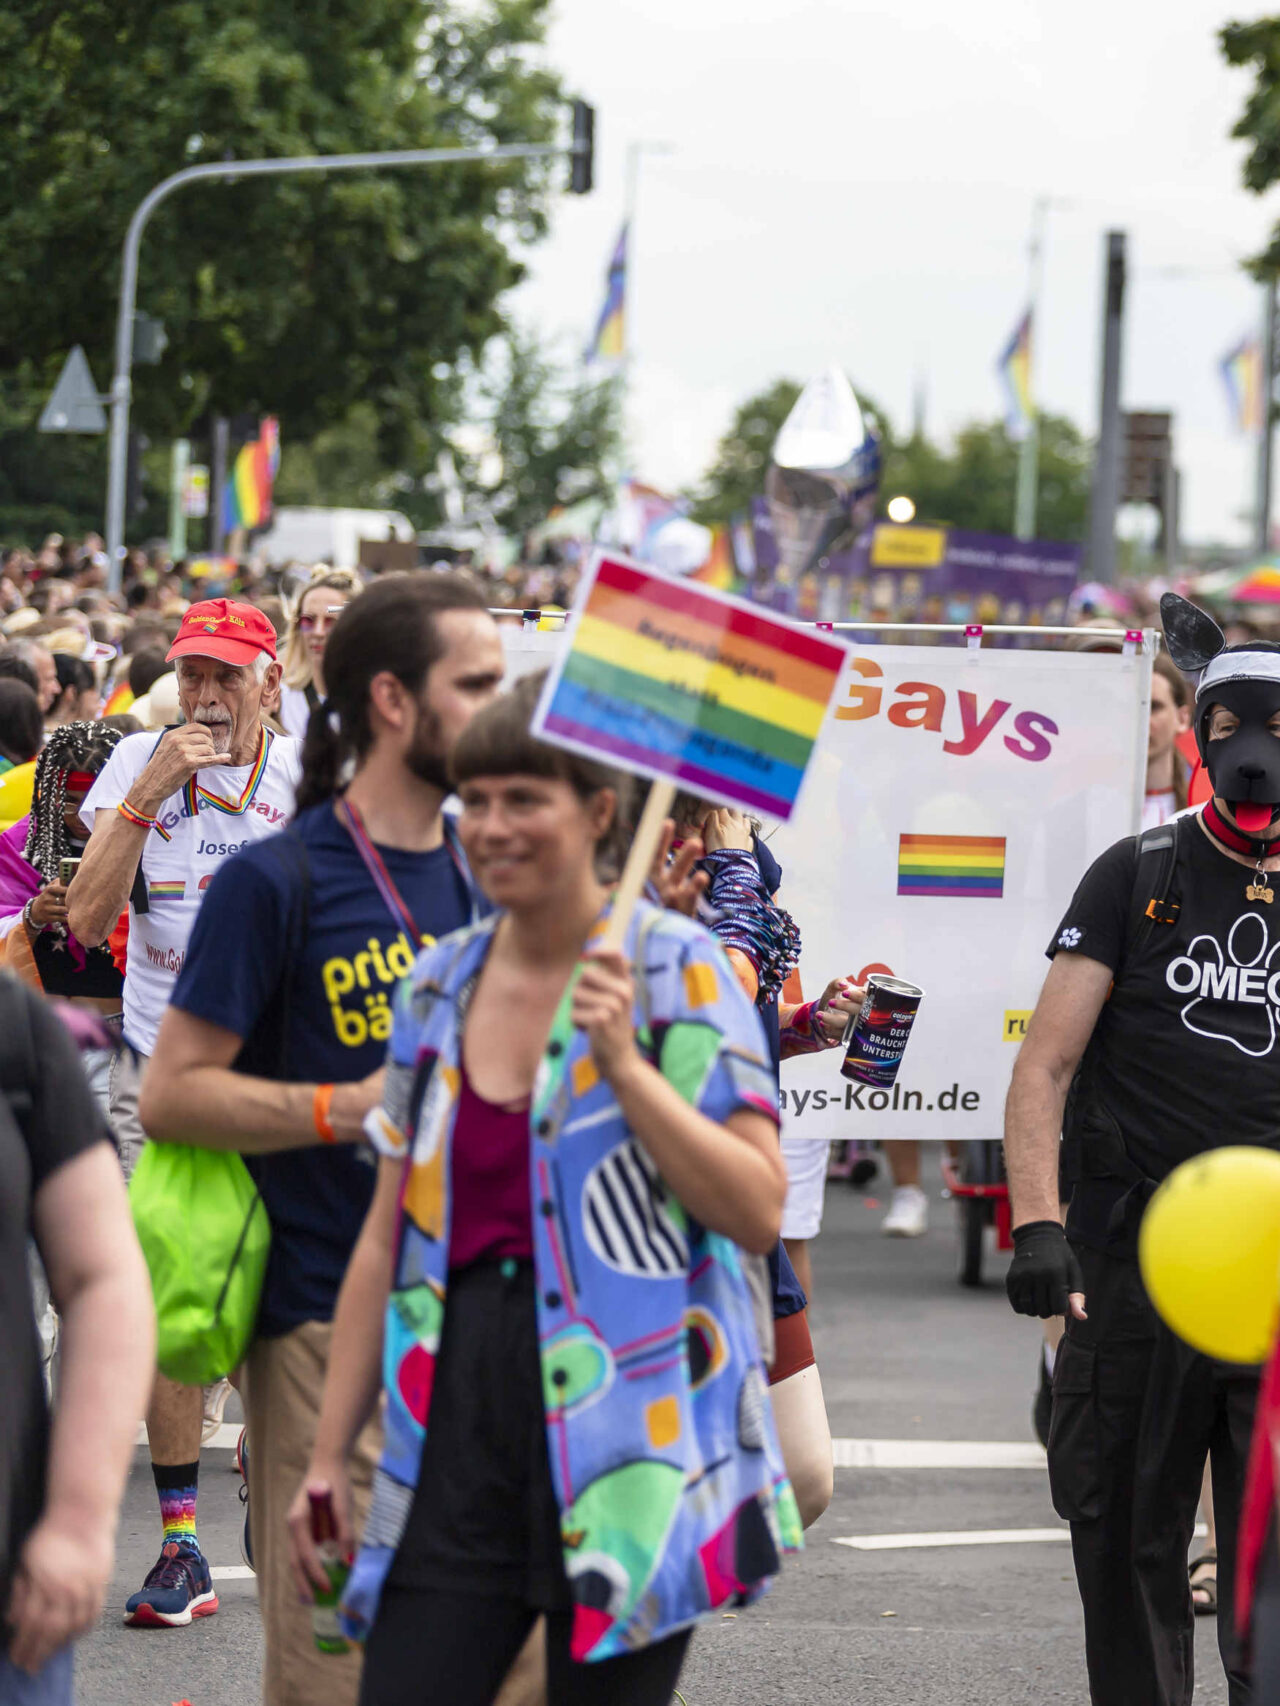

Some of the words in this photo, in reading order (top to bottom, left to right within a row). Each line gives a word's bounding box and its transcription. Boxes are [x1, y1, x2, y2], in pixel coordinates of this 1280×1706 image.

[834, 656, 1060, 763] Gays
[890, 1028, 907, 1037] DER
[869, 1033, 907, 1048] BRAUCHT
